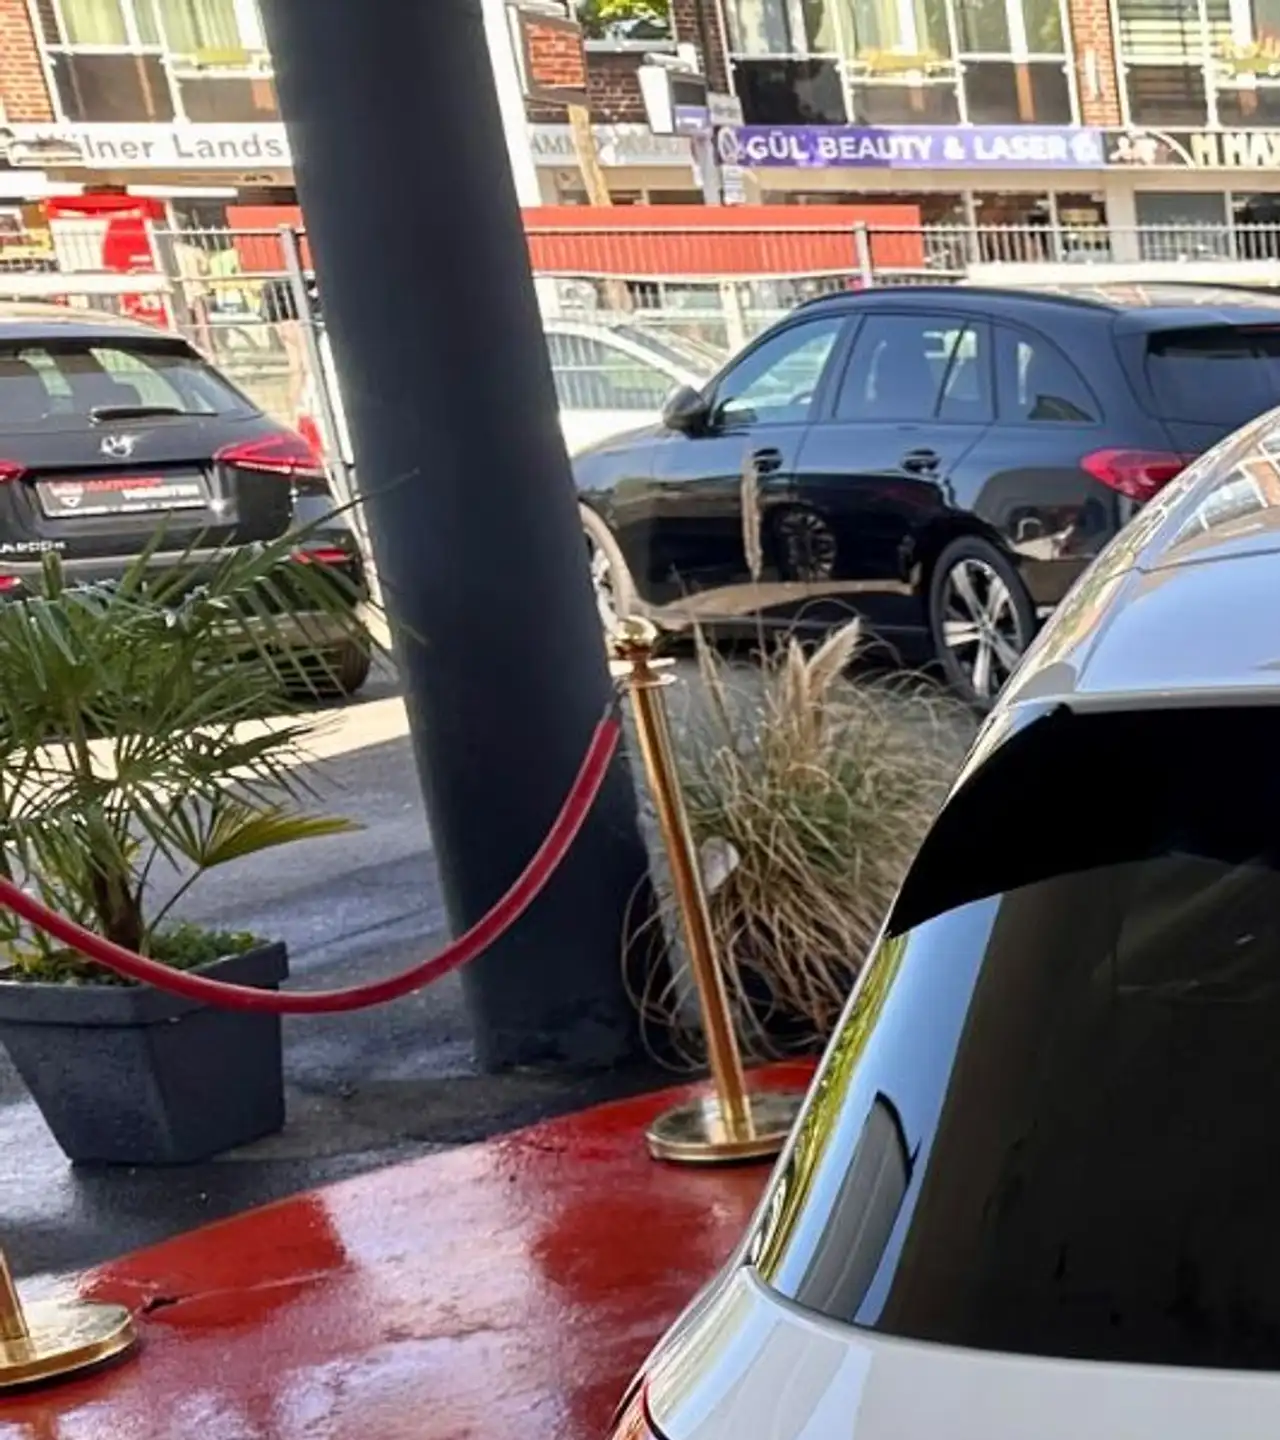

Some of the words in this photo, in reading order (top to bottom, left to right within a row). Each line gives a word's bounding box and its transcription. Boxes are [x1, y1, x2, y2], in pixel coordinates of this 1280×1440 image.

[37, 133, 155, 160] lner
[747, 130, 806, 160] GÜL
[820, 135, 932, 161] BEAUTY
[943, 136, 965, 160] &
[975, 135, 1067, 161] LASER
